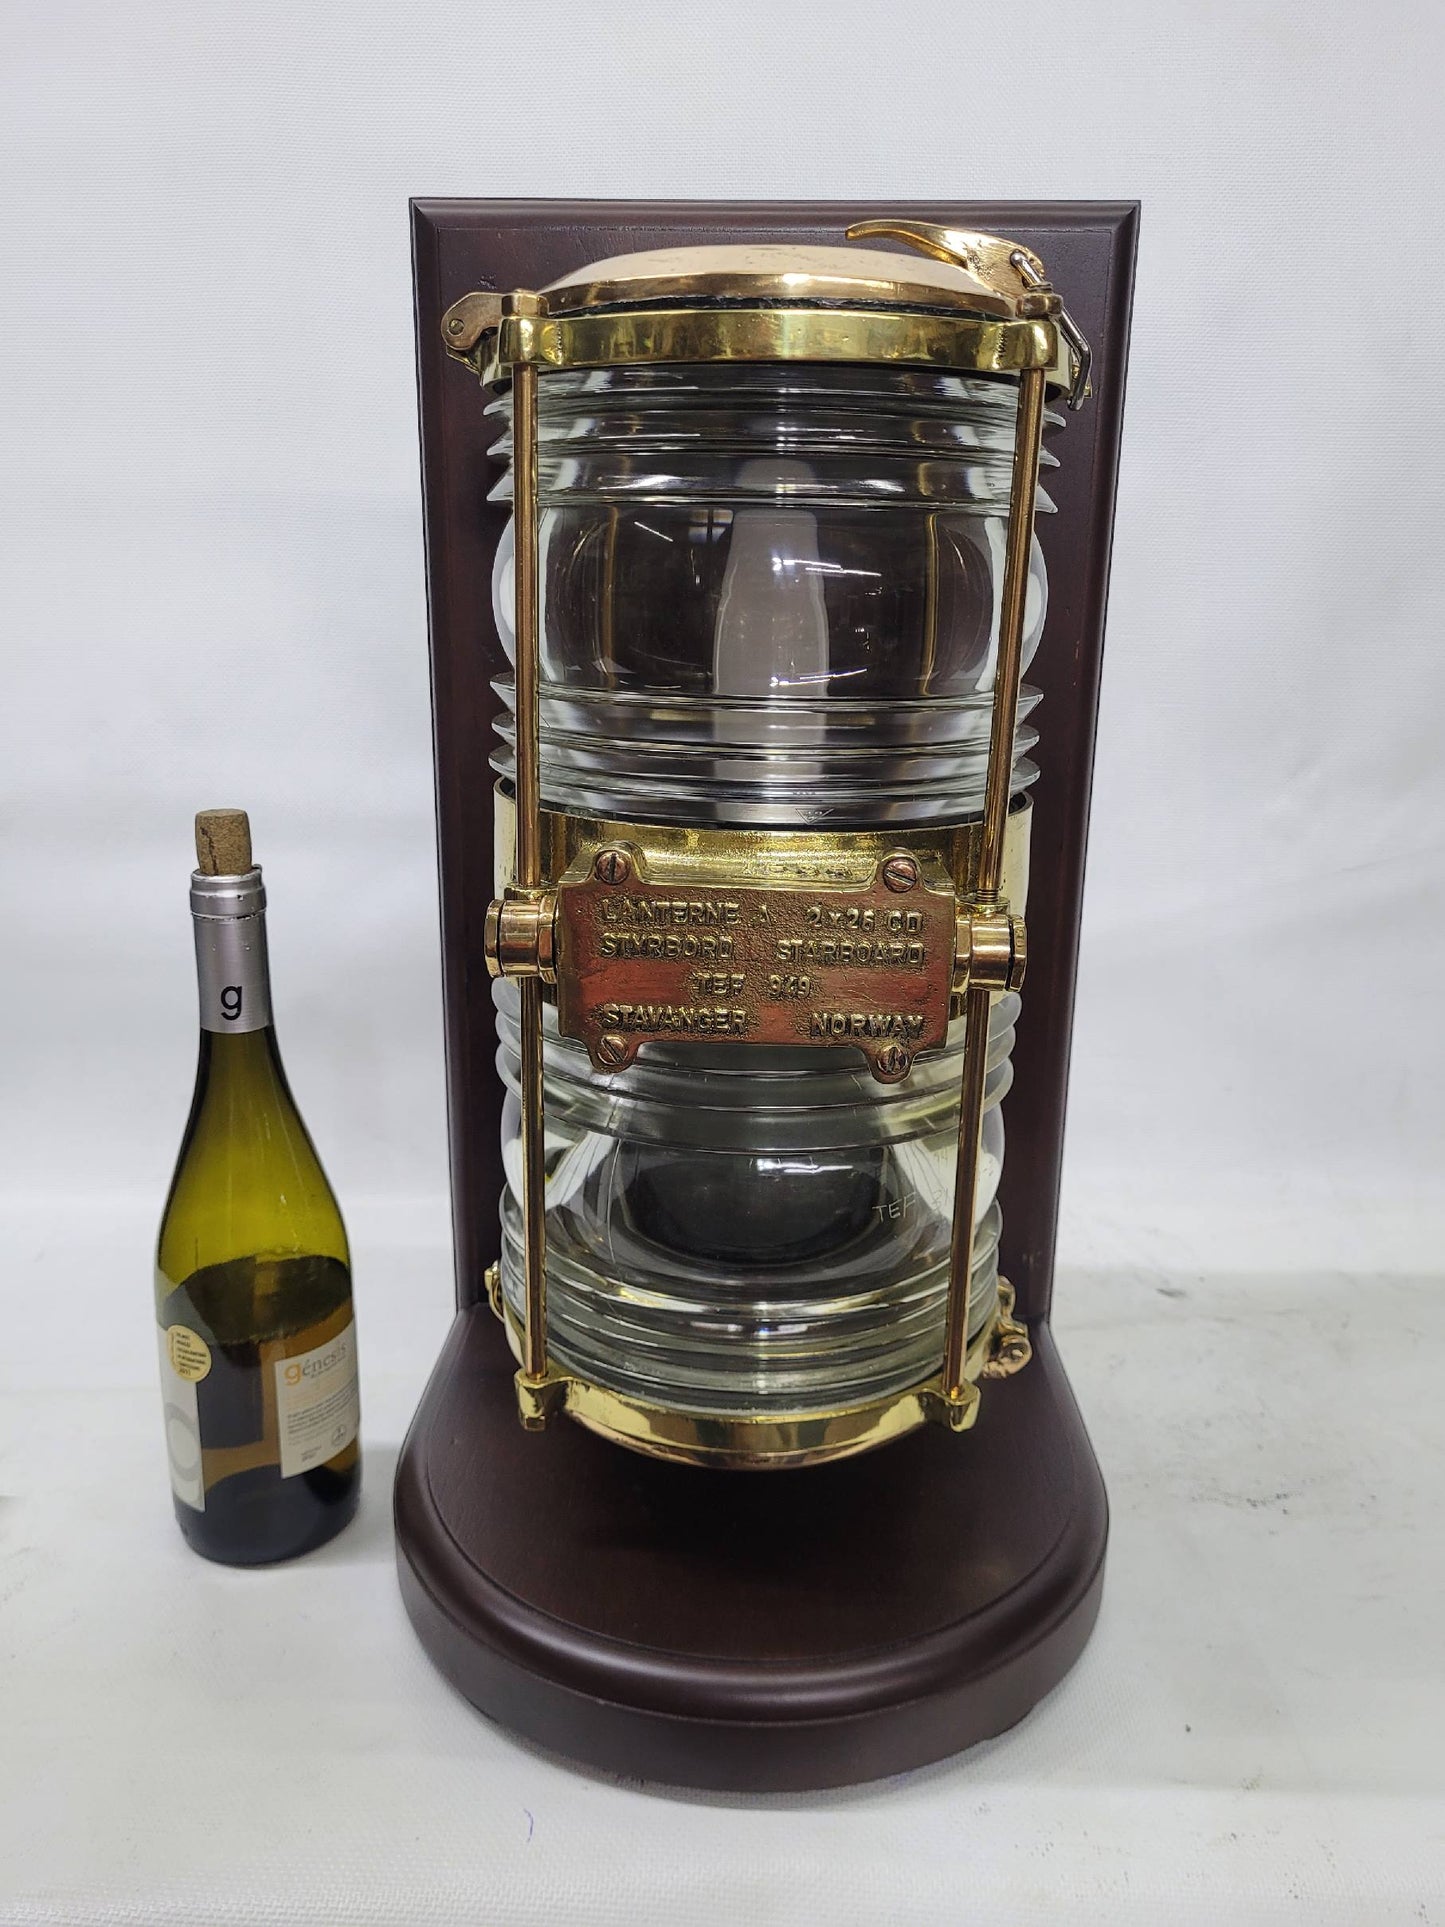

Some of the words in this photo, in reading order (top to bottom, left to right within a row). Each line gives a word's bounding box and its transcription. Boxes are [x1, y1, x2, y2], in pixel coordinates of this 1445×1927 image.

[601, 899, 741, 926] LANTERNE
[600, 933, 735, 960] STYRBORD
[776, 939, 925, 965] STARBOARD
[696, 972, 746, 996] TEF
[220, 985, 243, 1021] g
[601, 1004, 746, 1035] STAVANGER
[810, 1012, 924, 1038] NORWAY
[871, 1191, 917, 1222] TEF
